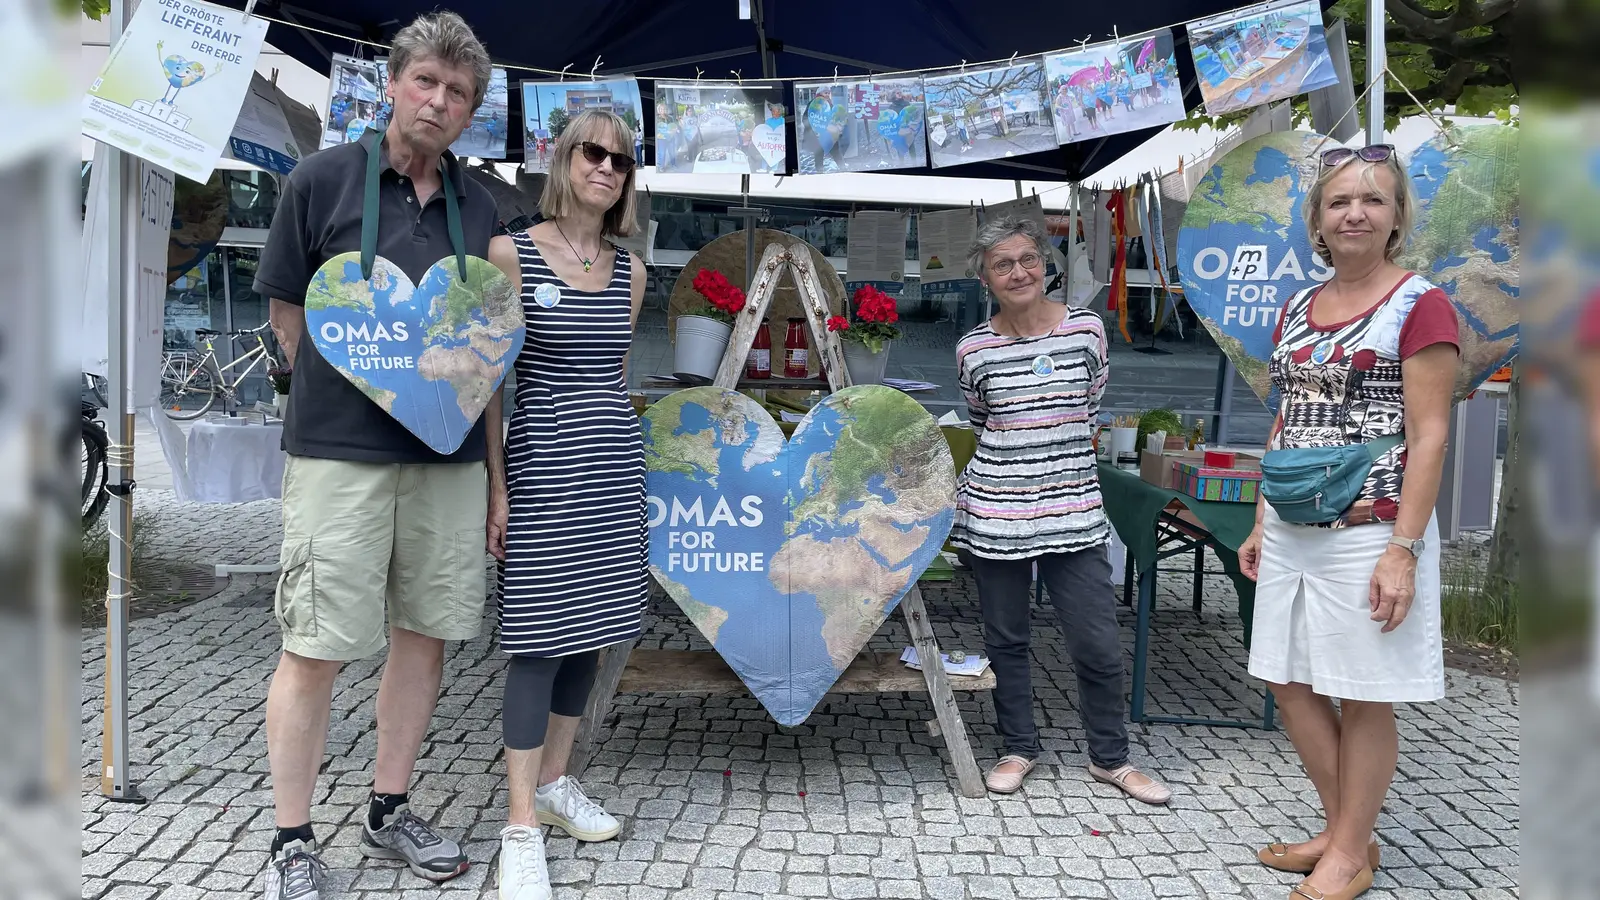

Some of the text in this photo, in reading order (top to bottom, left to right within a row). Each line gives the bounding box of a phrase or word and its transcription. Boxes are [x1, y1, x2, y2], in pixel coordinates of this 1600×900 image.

[161, 10, 242, 47] LIEFERANT
[191, 40, 242, 65] DER ERDE
[158, 108, 164, 116] 1
[1225, 284, 1278, 304] FOR
[1223, 306, 1284, 327] FUT
[320, 321, 409, 343] OMAS
[347, 344, 380, 356] FOR
[349, 356, 415, 371] FUTURE
[647, 494, 764, 528] OMAS
[668, 531, 716, 550] FOR
[668, 552, 764, 572] FUTURE
